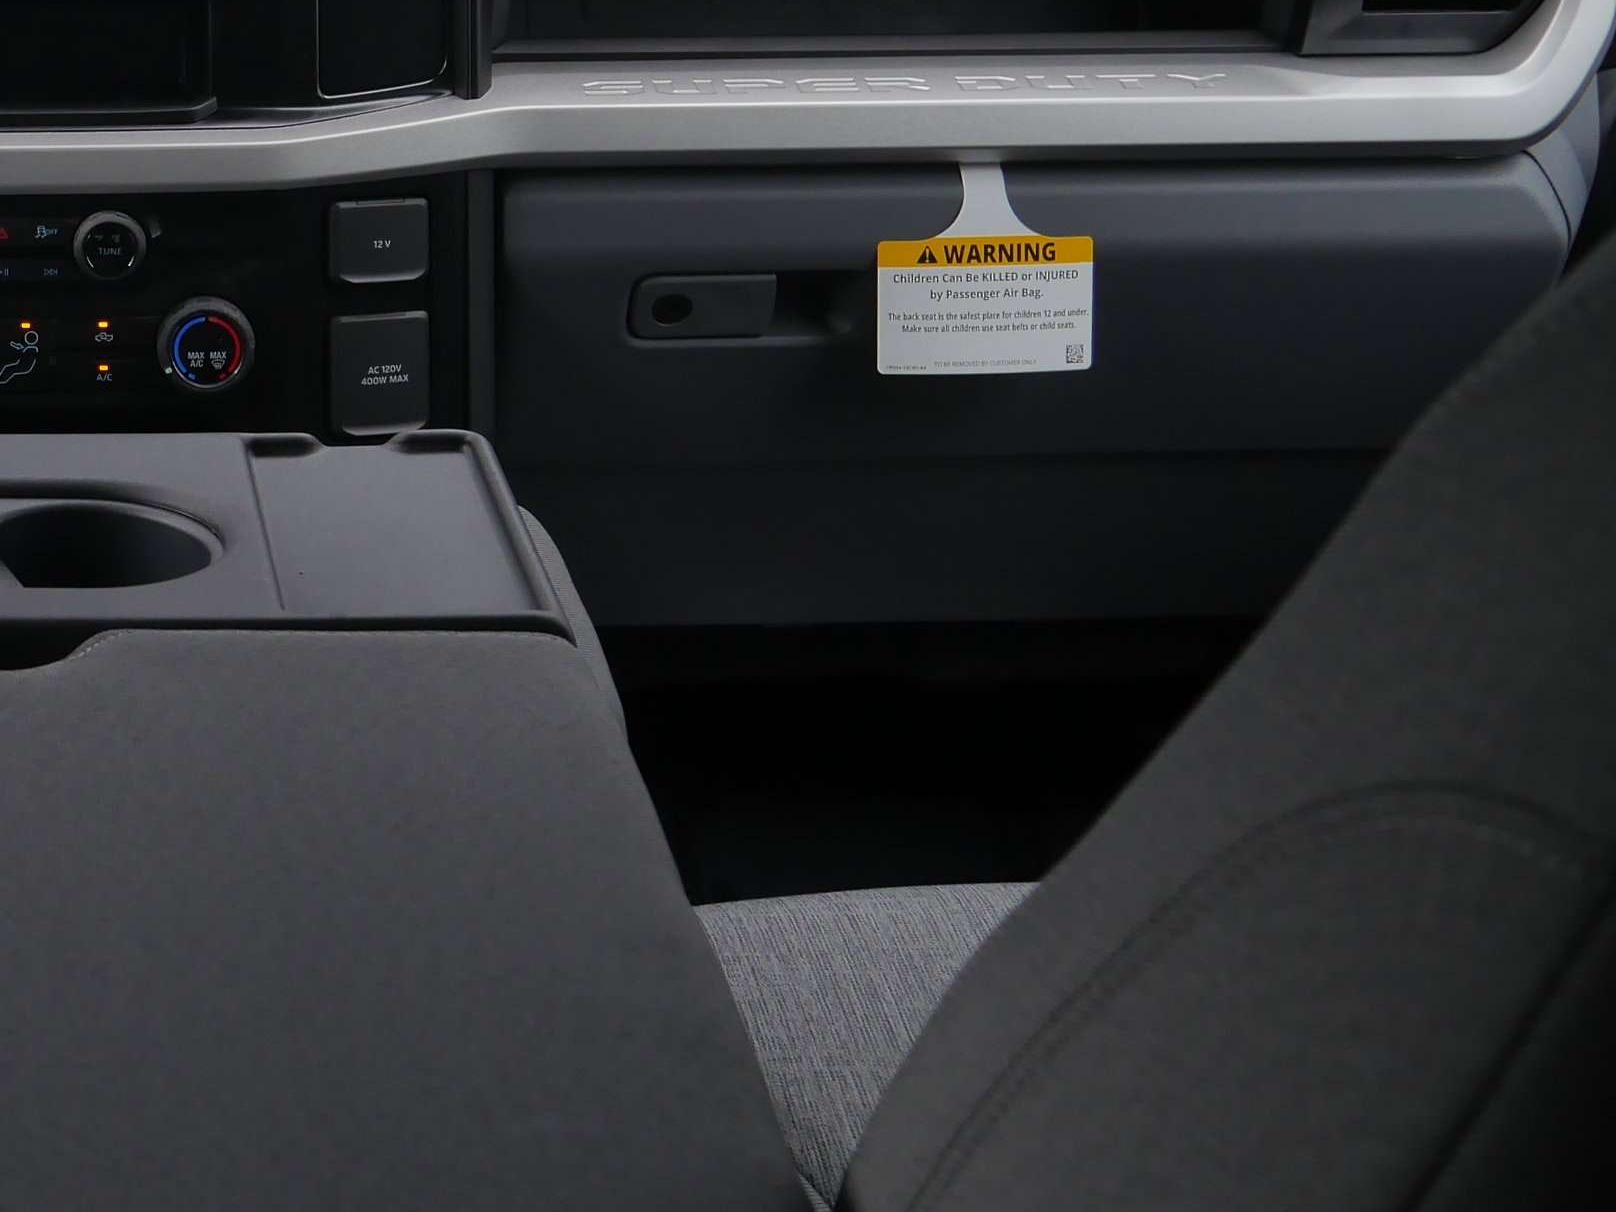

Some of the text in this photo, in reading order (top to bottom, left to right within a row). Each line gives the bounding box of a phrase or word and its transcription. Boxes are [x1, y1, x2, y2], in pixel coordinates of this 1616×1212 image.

[583, 73, 1226, 96] SUPER DUTY
[46, 228, 59, 236] OFF
[373, 240, 391, 248] 12 V
[98, 247, 122, 256] TUNE
[944, 242, 1056, 264] WARNING
[893, 273, 939, 284] Children
[942, 274, 962, 283] Can
[966, 273, 979, 282] Be
[982, 272, 1018, 282] KILLED
[1036, 270, 1078, 280] INJURED
[930, 288, 1044, 301] by Passenger Air Bag.
[889, 313, 901, 321] The
[946, 312, 958, 320] the
[960, 312, 981, 320] safest
[982, 311, 1000, 321] place
[1002, 310, 1012, 319] for
[1014, 310, 1041, 318] children
[1053, 309, 1066, 317] and
[1012, 323, 1028, 331] belts
[1040, 322, 1055, 330] child
[1057, 321, 1076, 329] seats.
[188, 352, 204, 360] MAX
[190, 359, 203, 368] A/C
[368, 364, 402, 374] AC 120V
[96, 372, 113, 382] A/C
[361, 374, 409, 386] 400W MAX
